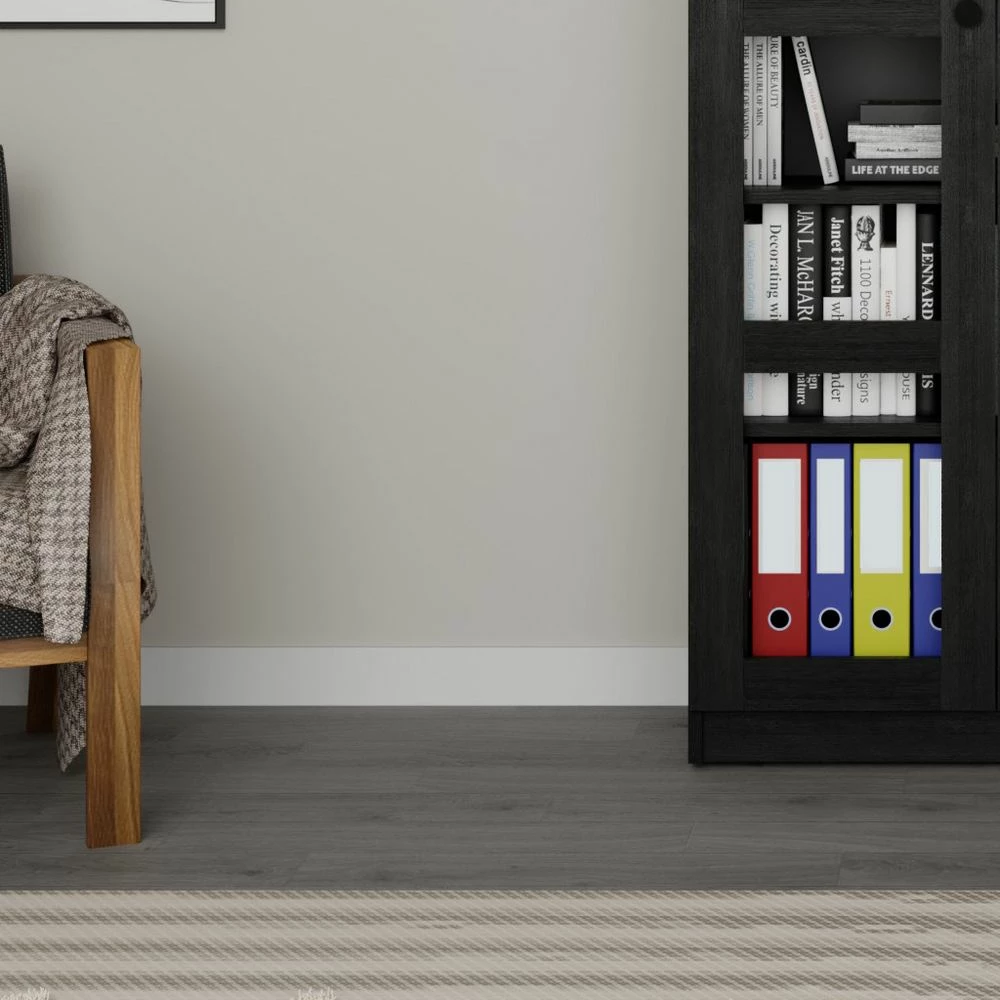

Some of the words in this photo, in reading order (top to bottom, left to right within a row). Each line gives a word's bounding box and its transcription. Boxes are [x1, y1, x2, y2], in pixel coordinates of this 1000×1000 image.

[770, 57, 778, 70] OF
[796, 41, 811, 76] cardin
[770, 72, 778, 108] BEAUTY
[851, 166, 873, 174] LIFE
[874, 166, 888, 174] AT
[889, 166, 909, 174] THE
[912, 165, 940, 174] EDGE
[796, 210, 814, 235] JAN
[830, 217, 845, 253] Janet
[766, 224, 782, 299] Decorating
[797, 238, 814, 253] L.
[831, 256, 845, 294] Fitch
[859, 258, 872, 287] 1100
[921, 241, 934, 320] LENNARD
